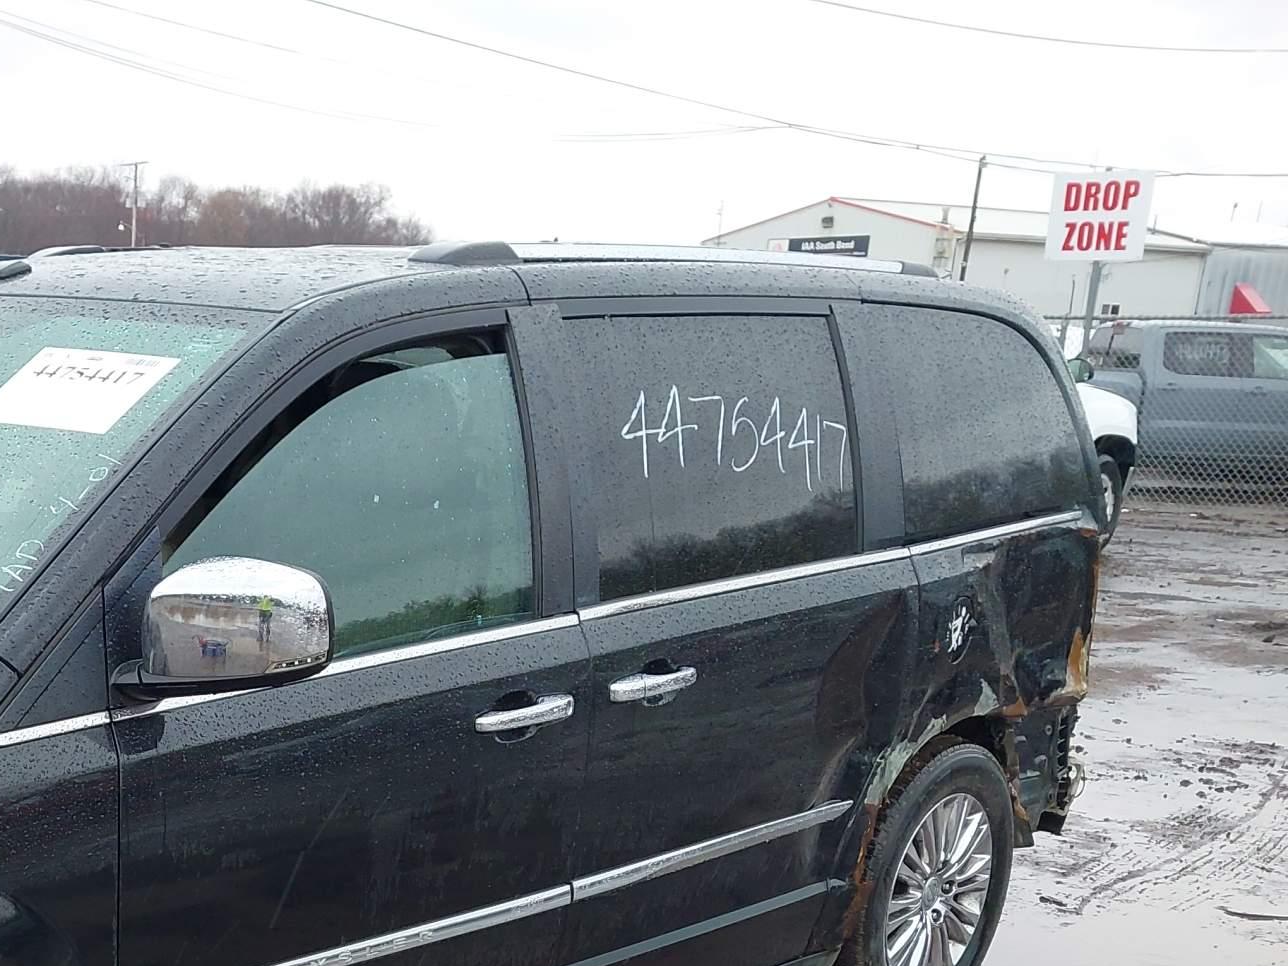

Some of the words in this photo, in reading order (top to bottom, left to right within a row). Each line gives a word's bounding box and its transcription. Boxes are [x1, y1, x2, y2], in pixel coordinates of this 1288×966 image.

[1064, 180, 1140, 212] DROP
[1062, 221, 1129, 252] ZONE
[33, 364, 145, 385] 44754417
[621, 384, 847, 492] 44754417
